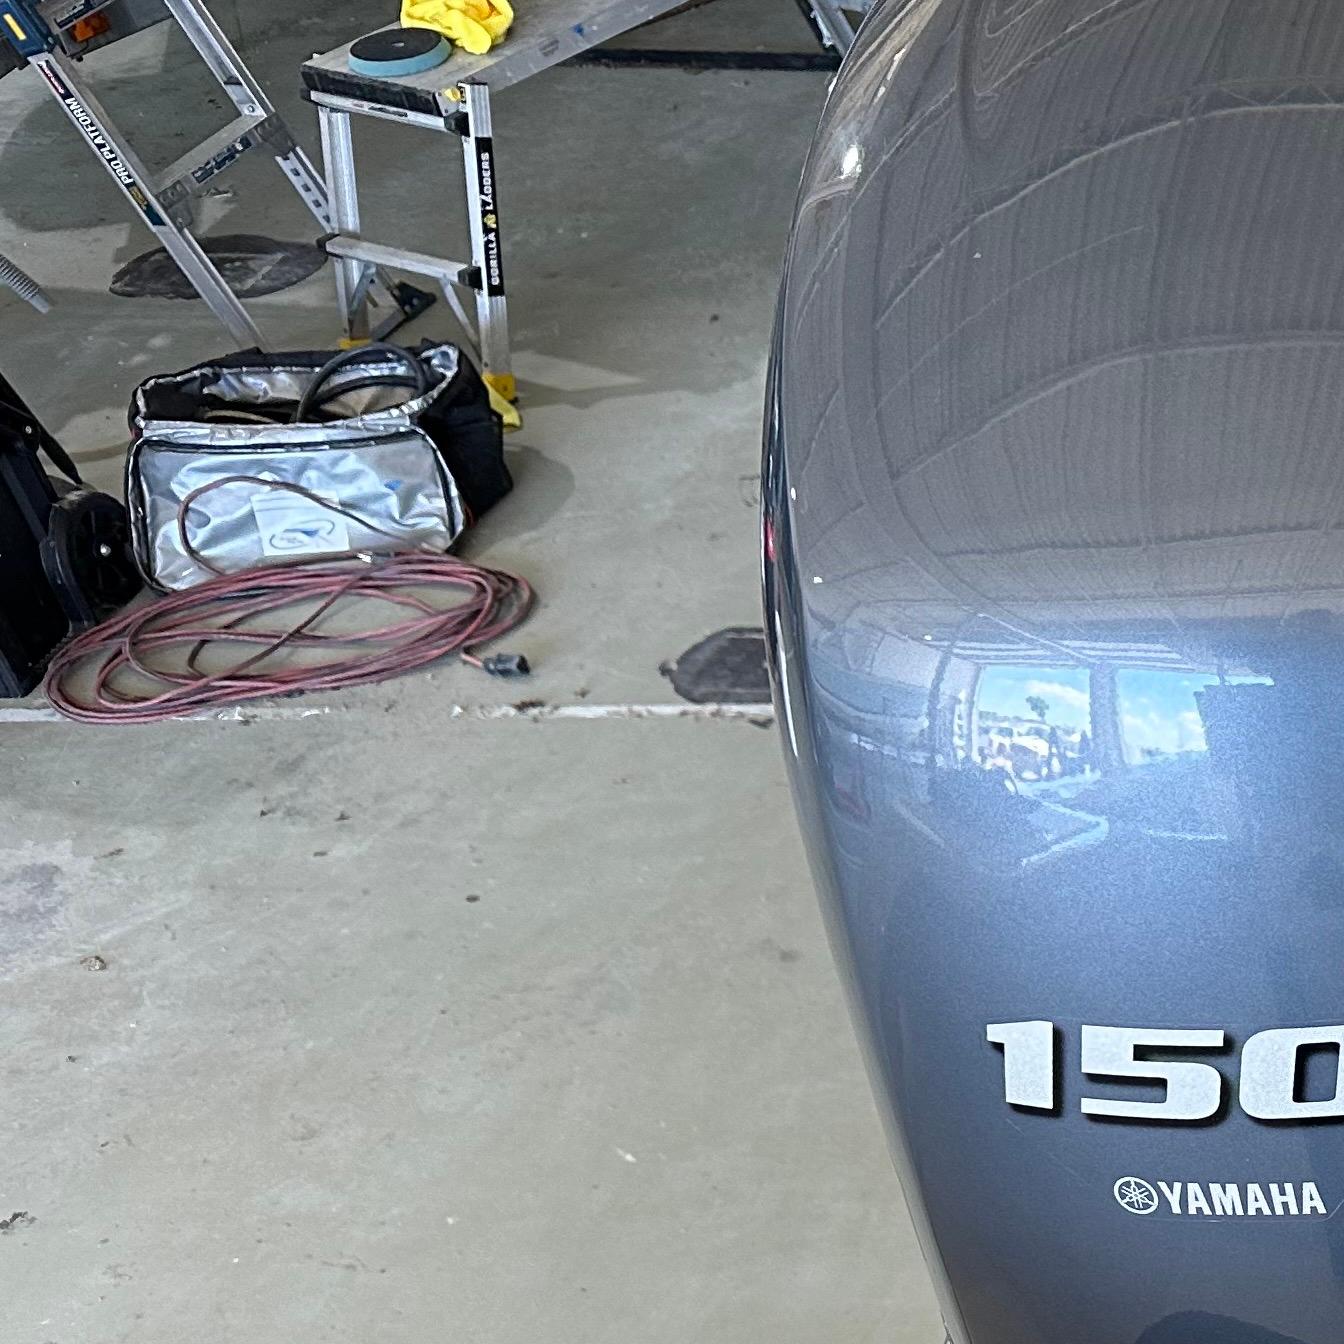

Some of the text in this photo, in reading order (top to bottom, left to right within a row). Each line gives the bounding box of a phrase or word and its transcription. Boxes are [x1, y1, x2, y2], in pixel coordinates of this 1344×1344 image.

[64, 97, 134, 184] PRO PLATFORM
[480, 152, 500, 286] GORILLA LADDERS
[1156, 1180, 1328, 1216] YAMAHA
